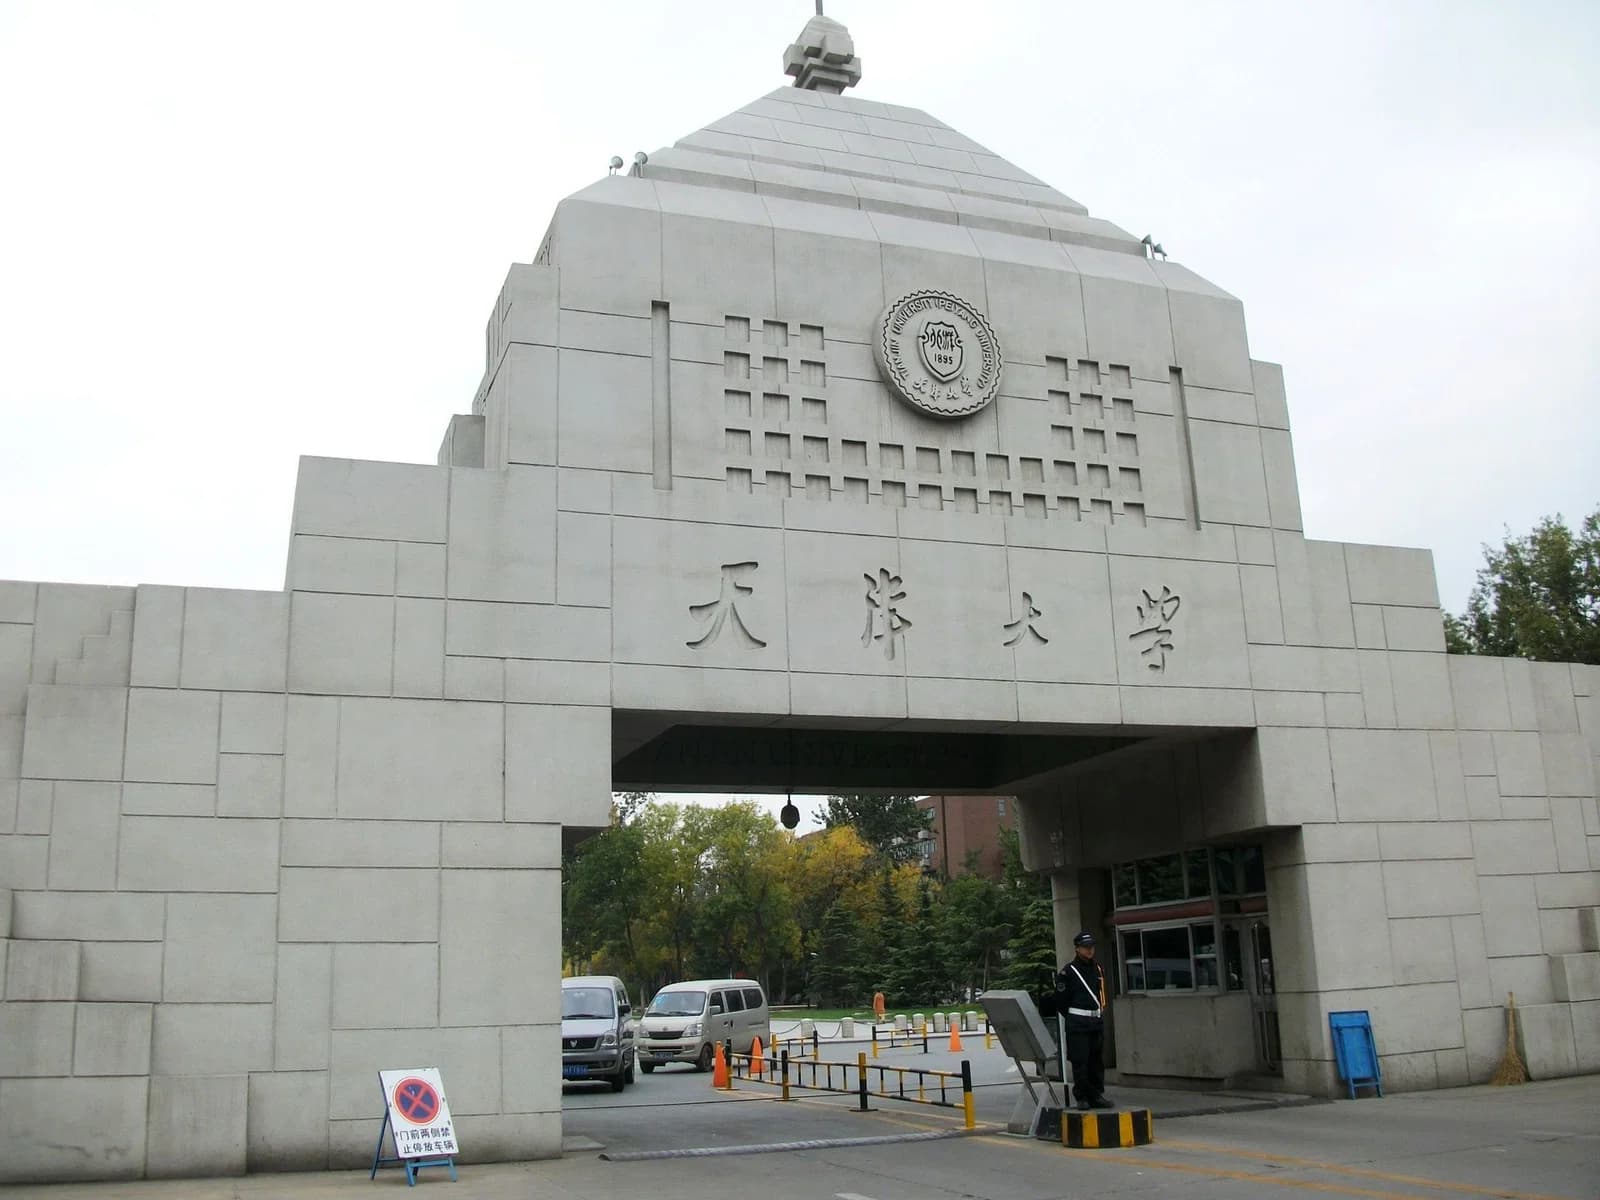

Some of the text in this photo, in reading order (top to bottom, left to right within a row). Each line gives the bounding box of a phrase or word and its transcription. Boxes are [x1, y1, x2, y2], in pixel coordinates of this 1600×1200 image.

[934, 353, 953, 365] 1895
[400, 1127, 451, 1141] 门前两侧禁
[403, 1140, 455, 1154] 止停放车辆
